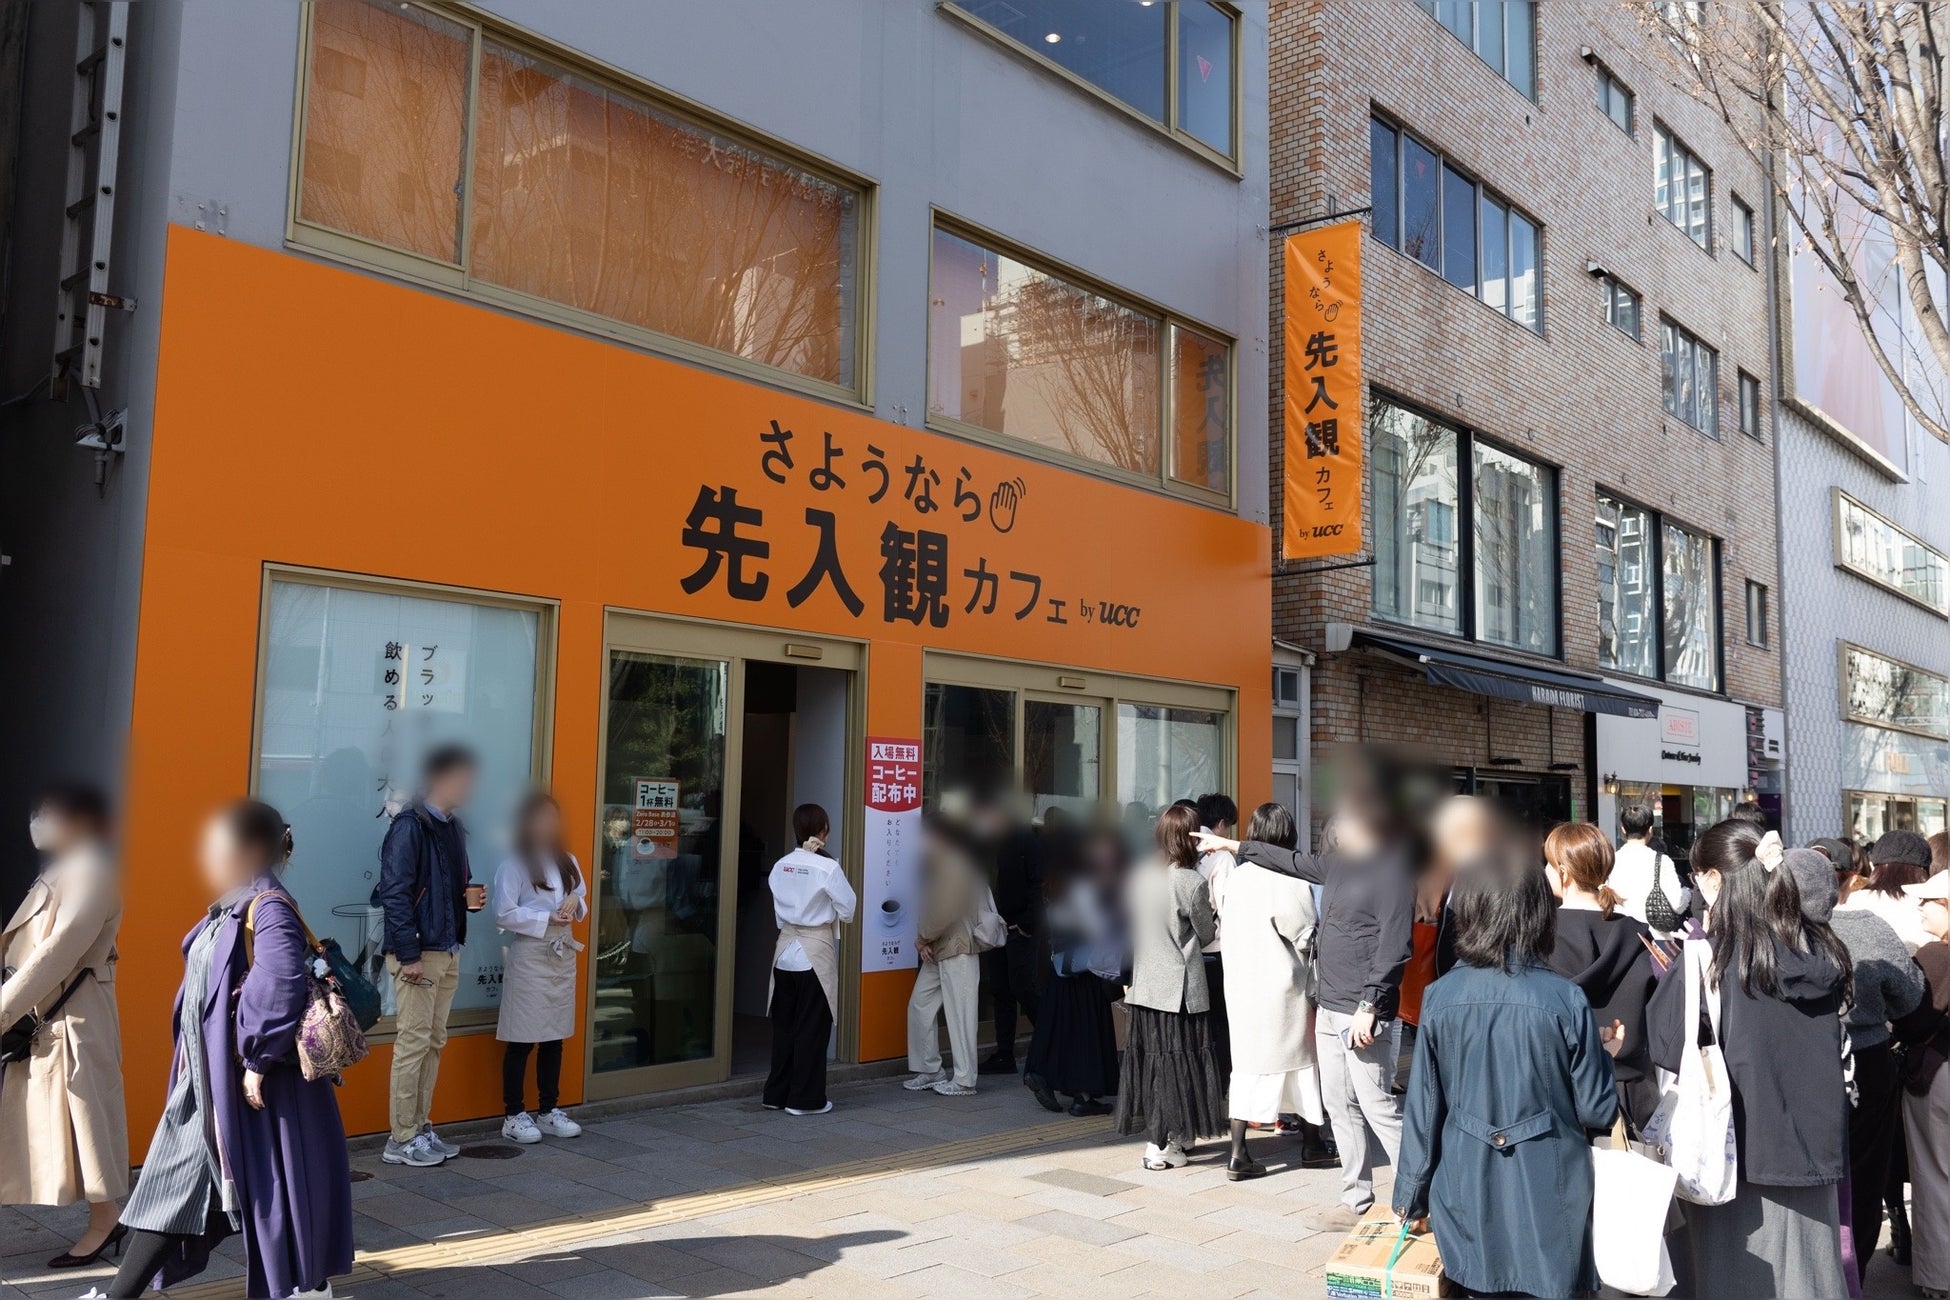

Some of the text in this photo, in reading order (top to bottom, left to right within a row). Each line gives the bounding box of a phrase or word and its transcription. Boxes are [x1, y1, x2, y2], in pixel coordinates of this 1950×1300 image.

[759, 419, 982, 522] さようなら
[1299, 528, 1309, 539] by
[1080, 598, 1095, 624] by
[1531, 686, 1585, 709] HARADA FLORIST
[873, 745, 916, 760] 入場無料
[872, 764, 917, 780] コーヒー
[640, 784, 675, 794] コーヒー
[871, 782, 917, 804] 配布中
[640, 795, 673, 807] 1杯無料
